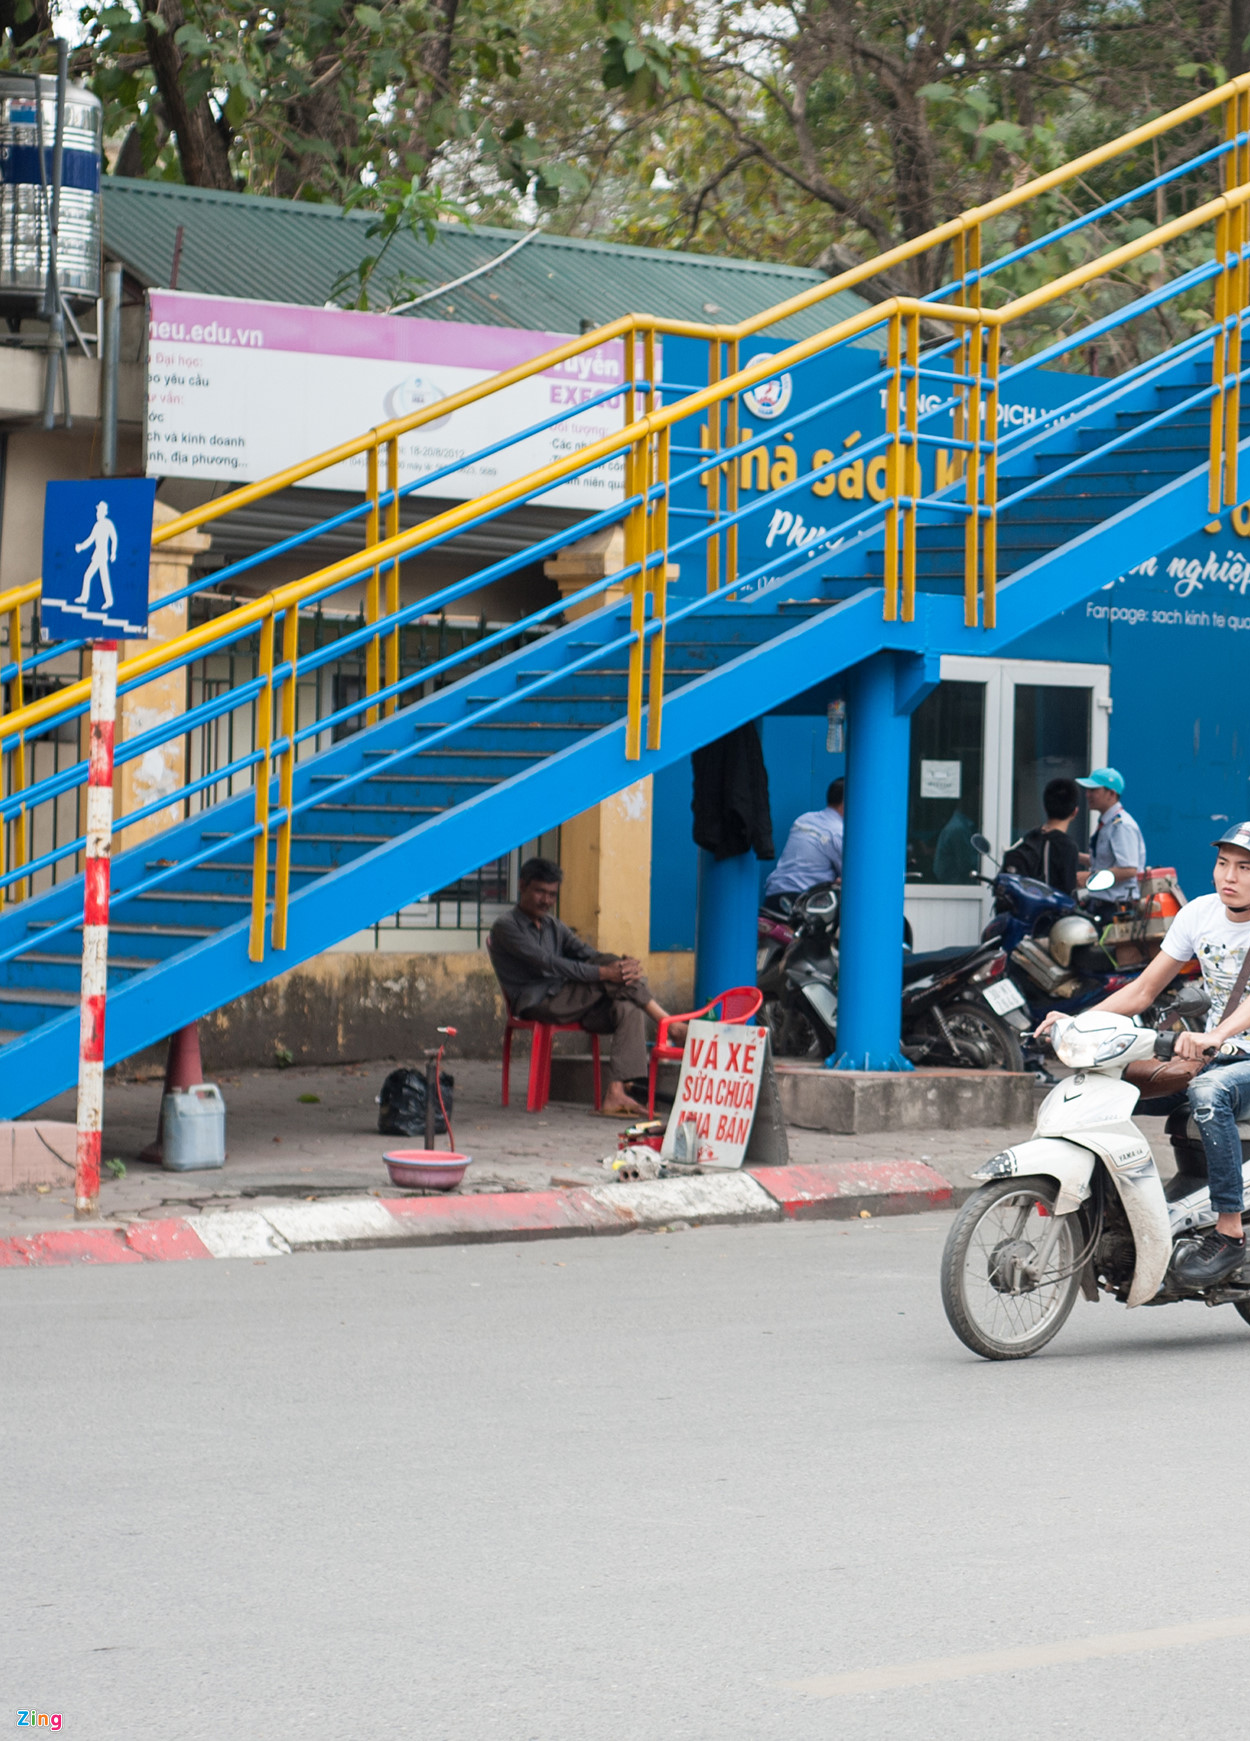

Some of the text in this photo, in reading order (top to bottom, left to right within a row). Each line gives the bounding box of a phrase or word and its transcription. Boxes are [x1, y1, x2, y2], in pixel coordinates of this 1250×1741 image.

[180, 431, 207, 444] kinh
[209, 435, 246, 447] doanh
[1086, 601, 1149, 625] Fanpage:
[1151, 610, 1183, 625] sach
[1185, 610, 1211, 626] kinh
[689, 1033, 719, 1071] VÁ
[715, 1110, 750, 1145] BÁN
